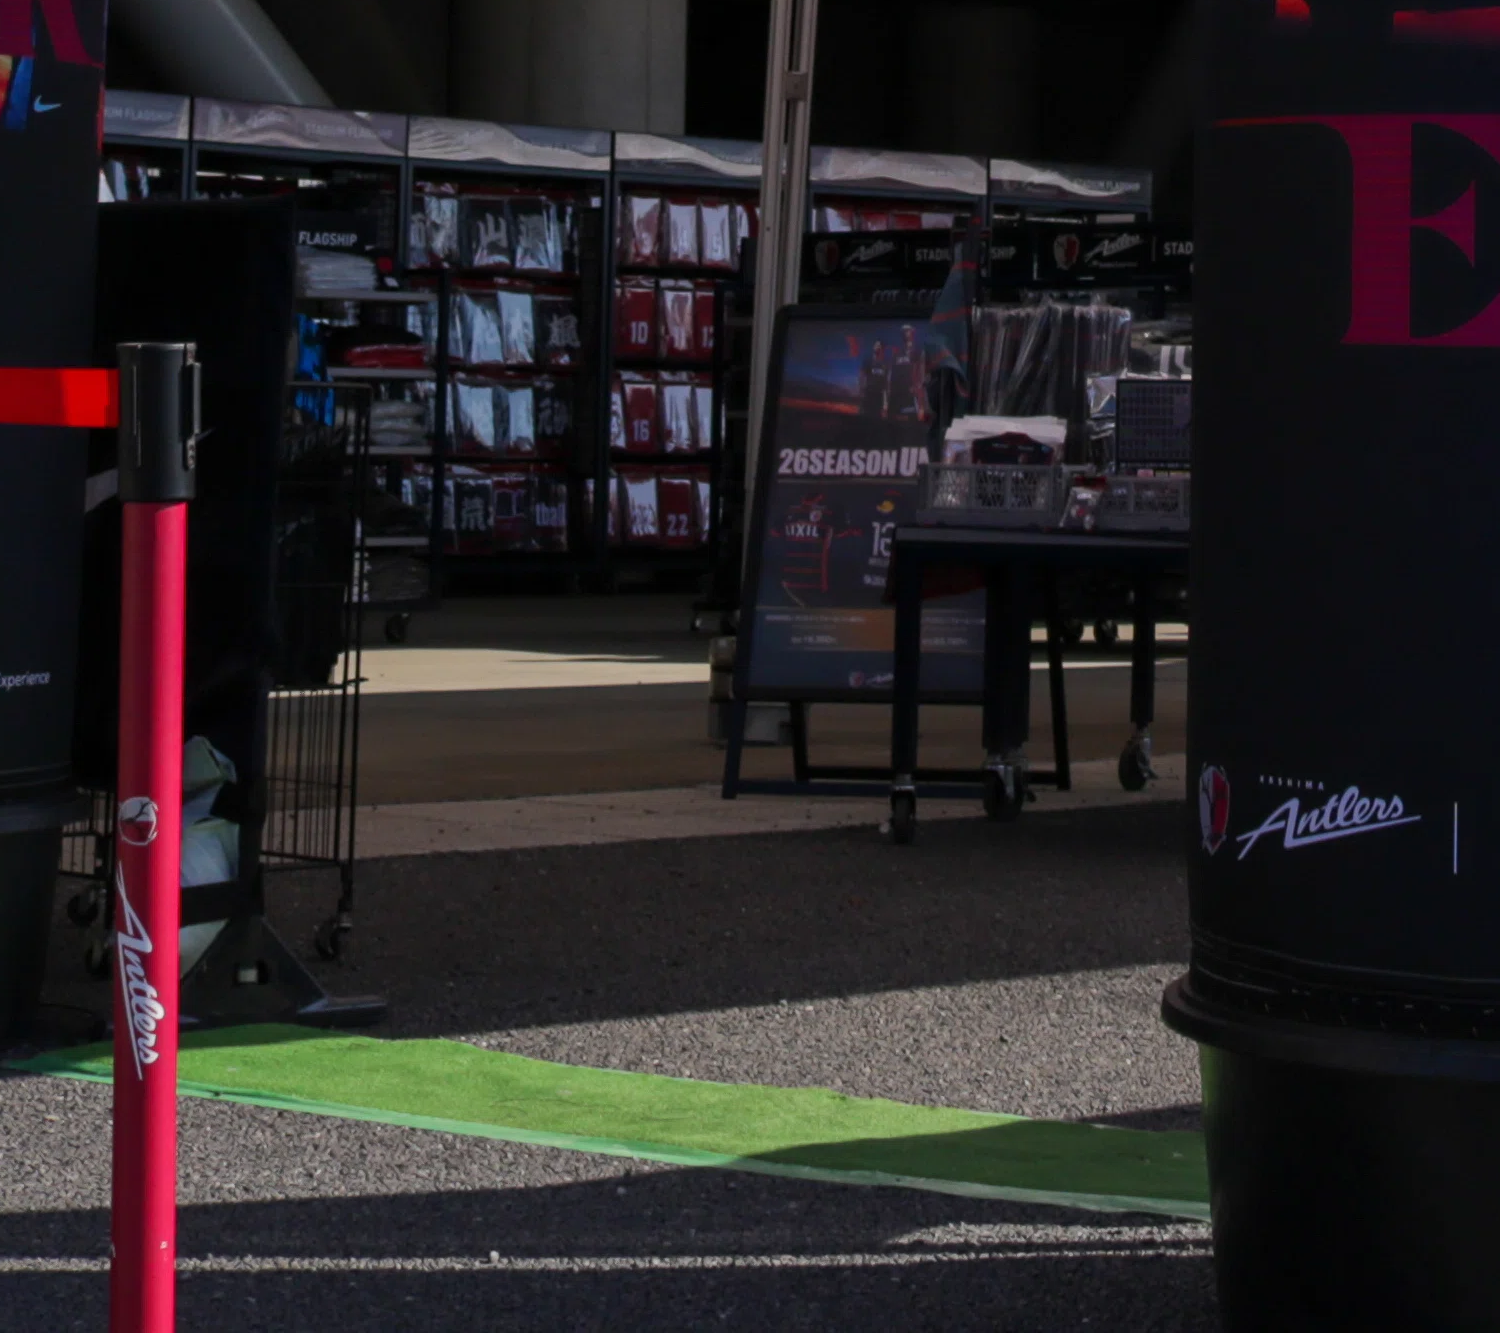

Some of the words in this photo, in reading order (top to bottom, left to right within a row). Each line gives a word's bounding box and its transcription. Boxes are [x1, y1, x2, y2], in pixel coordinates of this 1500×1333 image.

[1163, 240, 1195, 257] STAD
[777, 447, 899, 477] 26SEASON
[1235, 784, 1423, 861] Antlers
[116, 859, 166, 1082] Antlers
